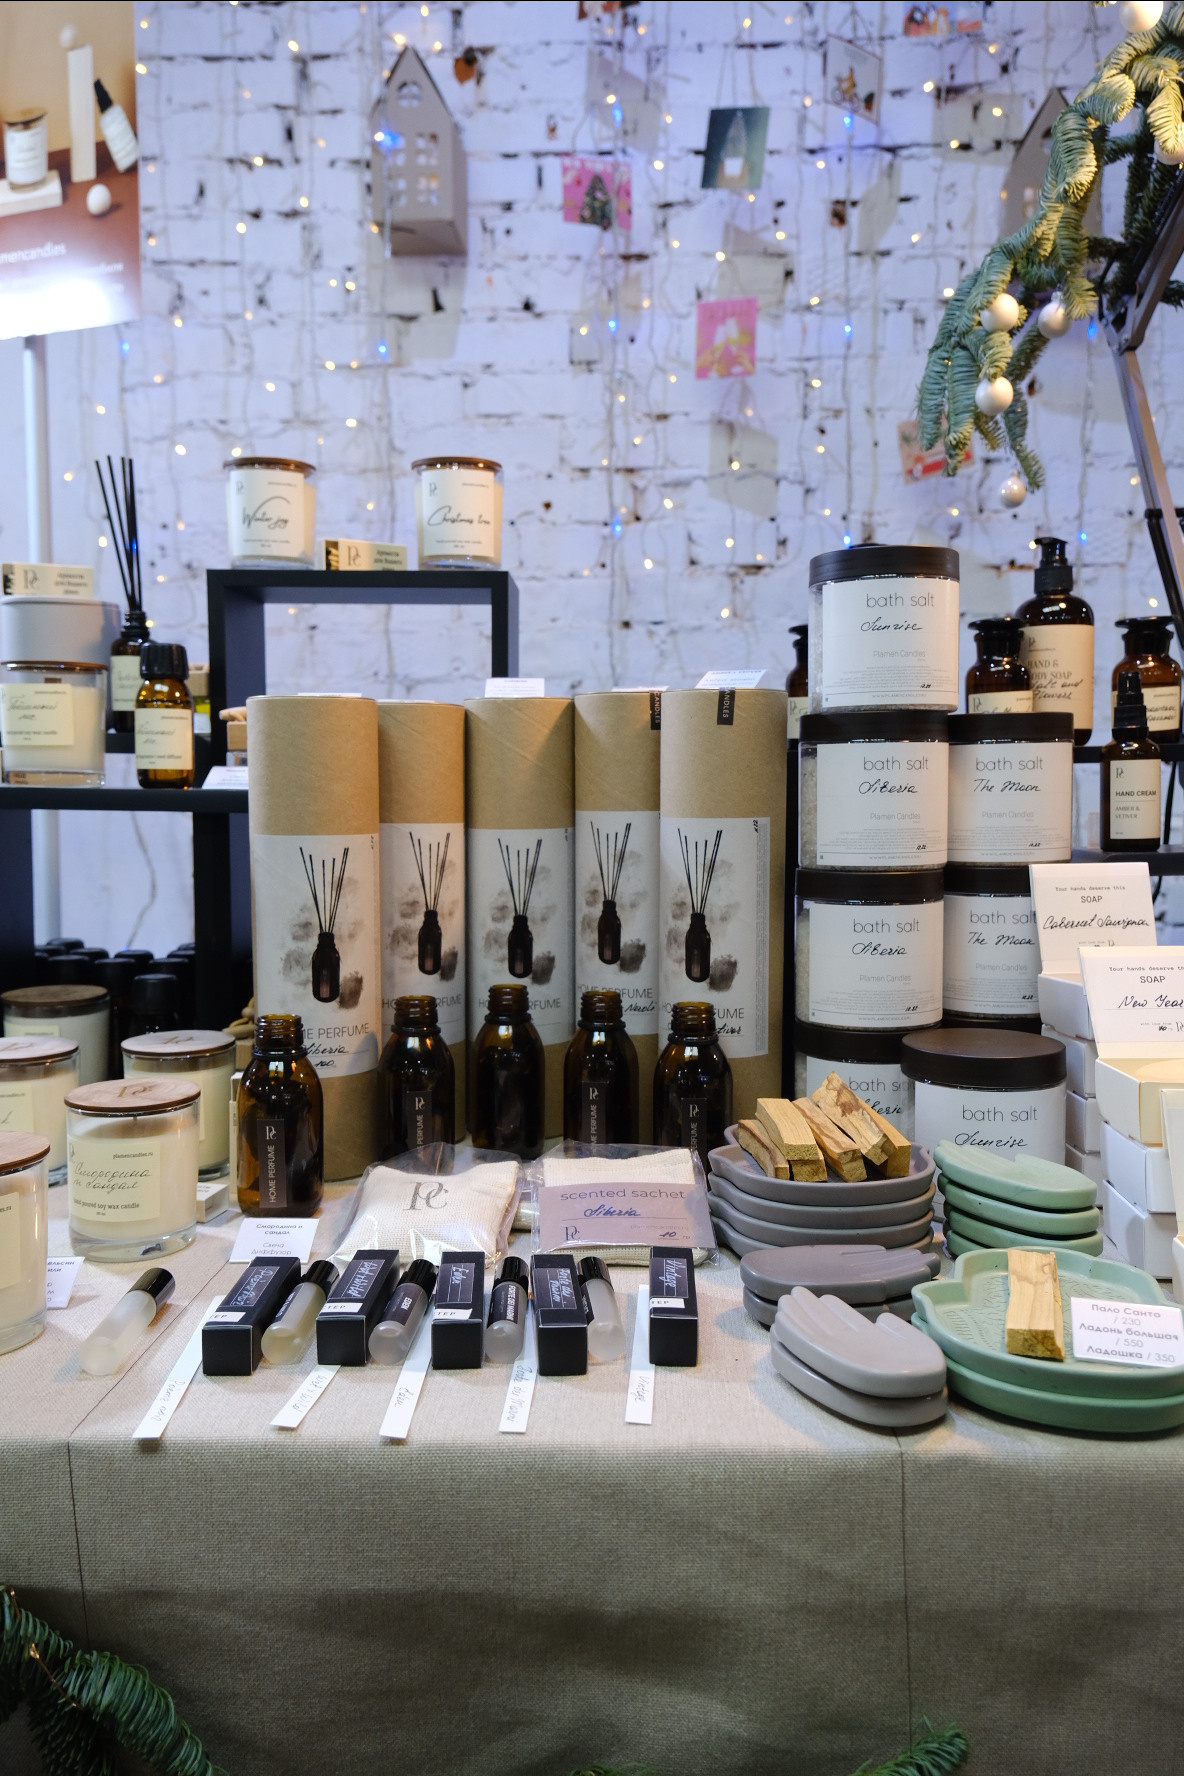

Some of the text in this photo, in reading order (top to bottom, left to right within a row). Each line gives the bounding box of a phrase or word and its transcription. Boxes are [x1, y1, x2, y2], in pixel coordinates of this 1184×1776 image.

[866, 592, 935, 608] bath salt
[860, 616, 922, 632] Sunrise
[873, 650, 899, 658] Plamen
[1027, 670, 1073, 679] ODY SOAP
[863, 755, 929, 771] bath salt
[975, 755, 1043, 771] bath salt
[858, 778, 918, 794] Siberia
[973, 778, 1041, 793] The Moon
[870, 812, 921, 820] Plamen Candles
[1080, 895, 1103, 904] SOAP
[970, 909, 1037, 925] bath salt
[853, 917, 920, 934] bath salt
[967, 931, 988, 945] The
[851, 941, 907, 956] Siberia
[859, 974, 886, 982] Plamen
[1139, 975, 1166, 984] SOAP
[1117, 994, 1148, 1009] New
[317, 1022, 370, 1040] PERFUME
[849, 1077, 886, 1092] bath
[962, 1104, 1038, 1122] bath salt
[416, 1114, 424, 1145] PERFUME
[690, 1122, 698, 1149] ERFUME
[954, 1130, 1028, 1147] Sunrise
[267, 1144, 277, 1203] HOME PERFUME
[560, 1187, 686, 1201] scented sachet
[97, 1202, 106, 1210] soy
[120, 1202, 140, 1210] candle
[583, 1203, 642, 1218] Siberia
[250, 1248, 293, 1256] Диффузор
[658, 1258, 686, 1288] Vintage
[507, 1284, 517, 1299] FORTE
[400, 1296, 413, 1310] EDEN
[1091, 1303, 1162, 1318] Пало Санто
[1121, 1316, 1142, 1326] 230
[1079, 1322, 1179, 1341] Ладонь большая
[1123, 1338, 1144, 1348] 550
[1086, 1344, 1144, 1359] Ладошка
[1154, 1352, 1176, 1363] 350
